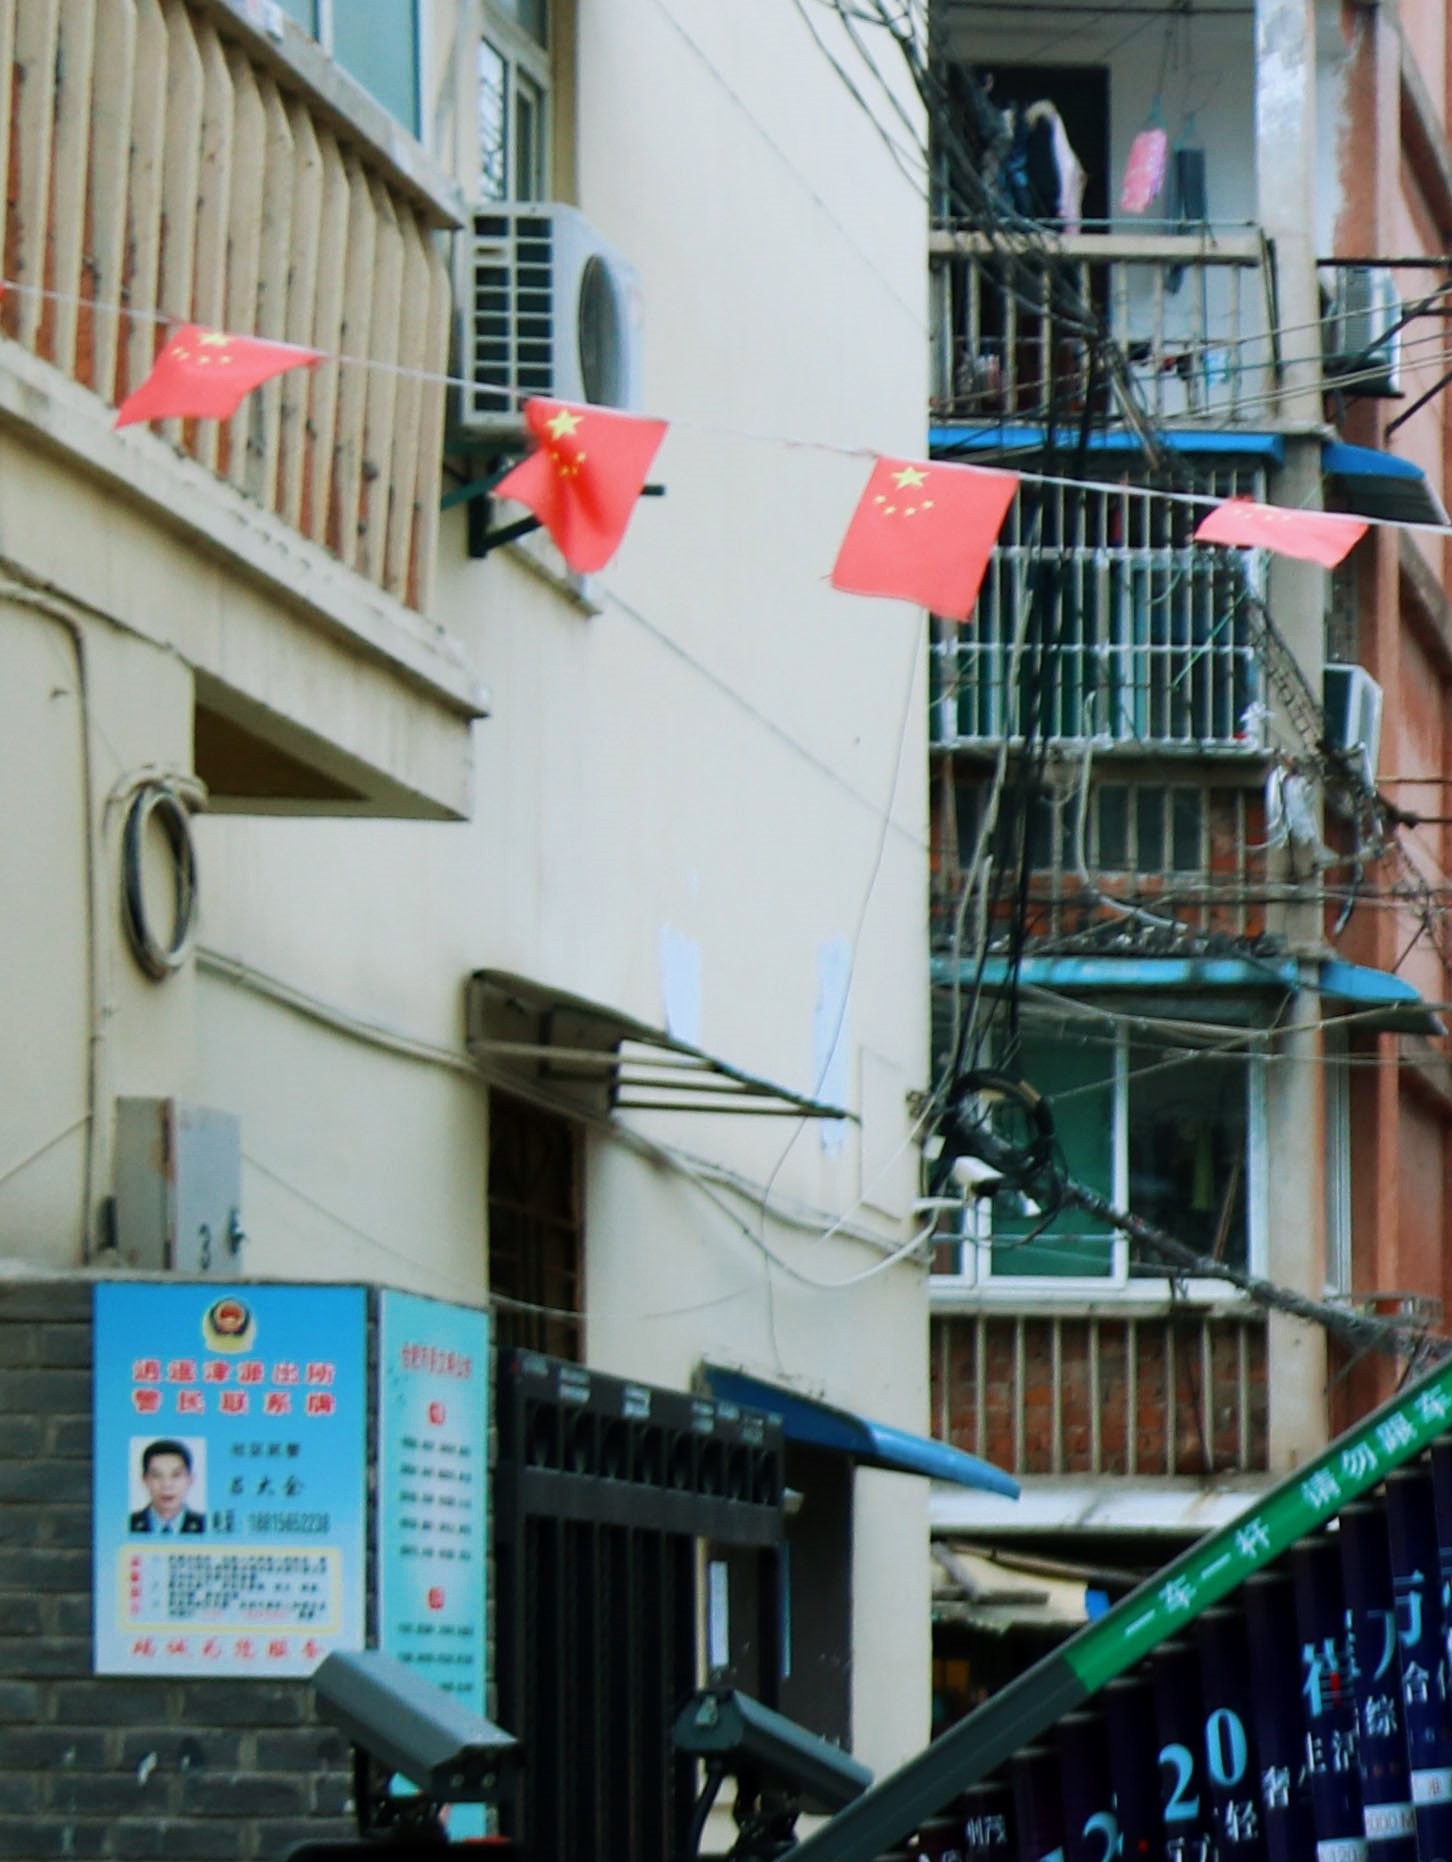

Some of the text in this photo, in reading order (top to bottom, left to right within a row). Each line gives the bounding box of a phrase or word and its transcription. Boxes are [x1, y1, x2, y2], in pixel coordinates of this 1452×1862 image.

[1123, 1515, 1272, 1640] 一车一杆
[1301, 1383, 1452, 1510] 请勿跟车
